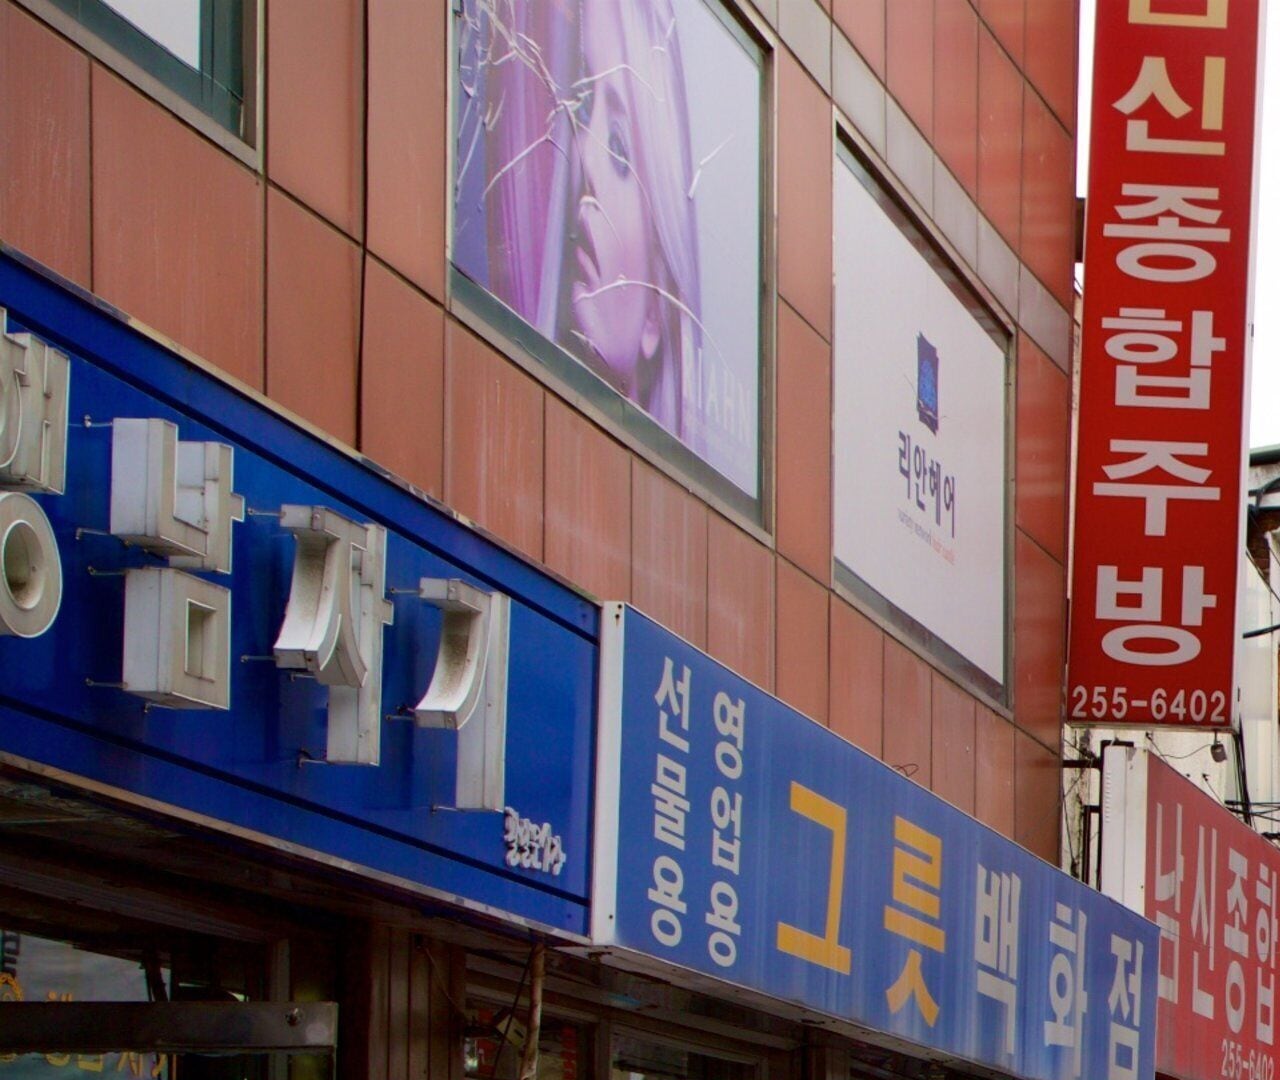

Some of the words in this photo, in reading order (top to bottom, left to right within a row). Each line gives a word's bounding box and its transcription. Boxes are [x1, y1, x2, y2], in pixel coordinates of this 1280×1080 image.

[1093, 0, 1231, 666] 신종합주방
[898, 430, 955, 538] 리안헤어
[648, 656, 692, 947] 선물용
[705, 691, 746, 968] 영업용
[1071, 684, 1226, 723] 255-6402
